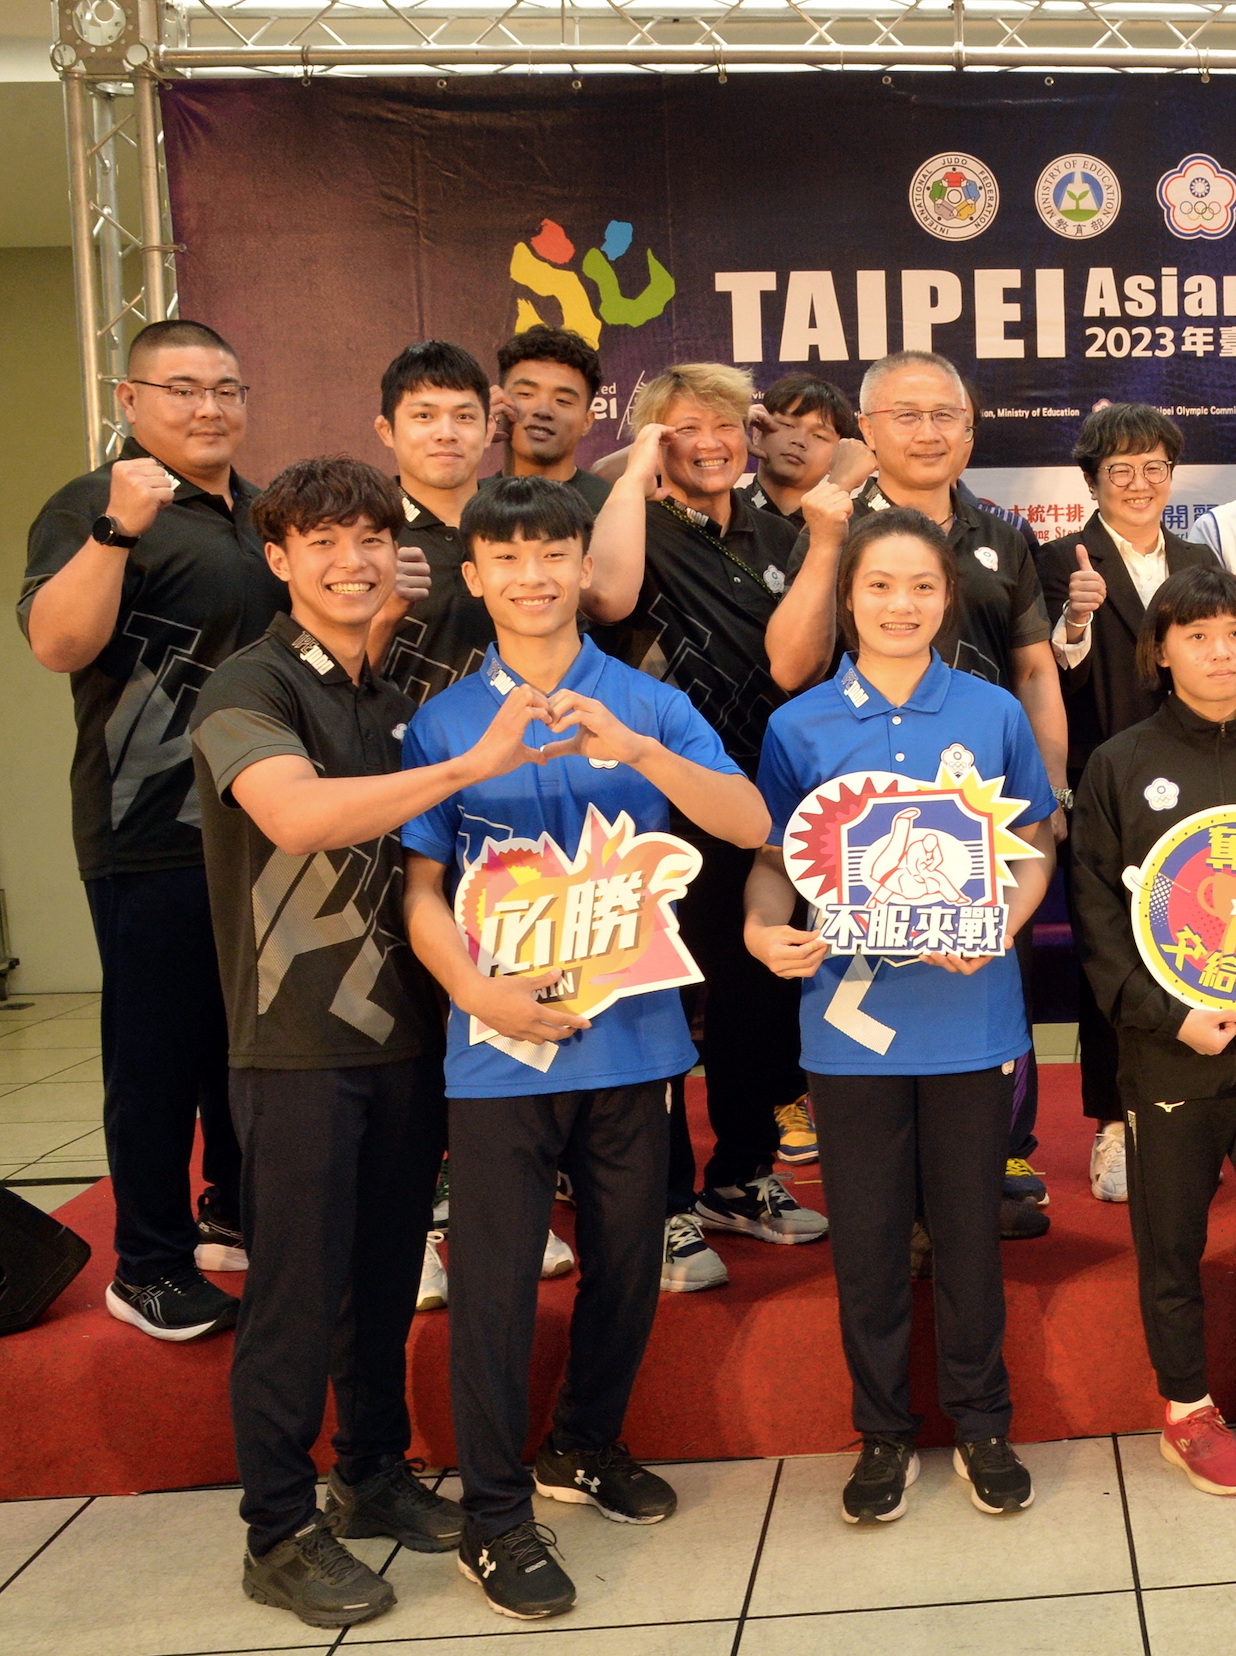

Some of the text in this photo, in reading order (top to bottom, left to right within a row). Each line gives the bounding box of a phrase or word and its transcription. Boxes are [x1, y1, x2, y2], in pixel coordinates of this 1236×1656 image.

[915, 157, 995, 235] INTERNATIONAL JUDO FEDERATION
[1041, 160, 1115, 219] MINISTRY OF EDUCATION
[1055, 218, 1105, 236] 教育部
[714, 268, 1066, 363] TAIPEI
[997, 407, 1030, 419] Ministry
[1031, 407, 1041, 417] of
[1042, 407, 1080, 417] Education
[1176, 405, 1209, 417] Olympic
[476, 869, 644, 978] 必勝
[823, 904, 1001, 950] 不服來戰
